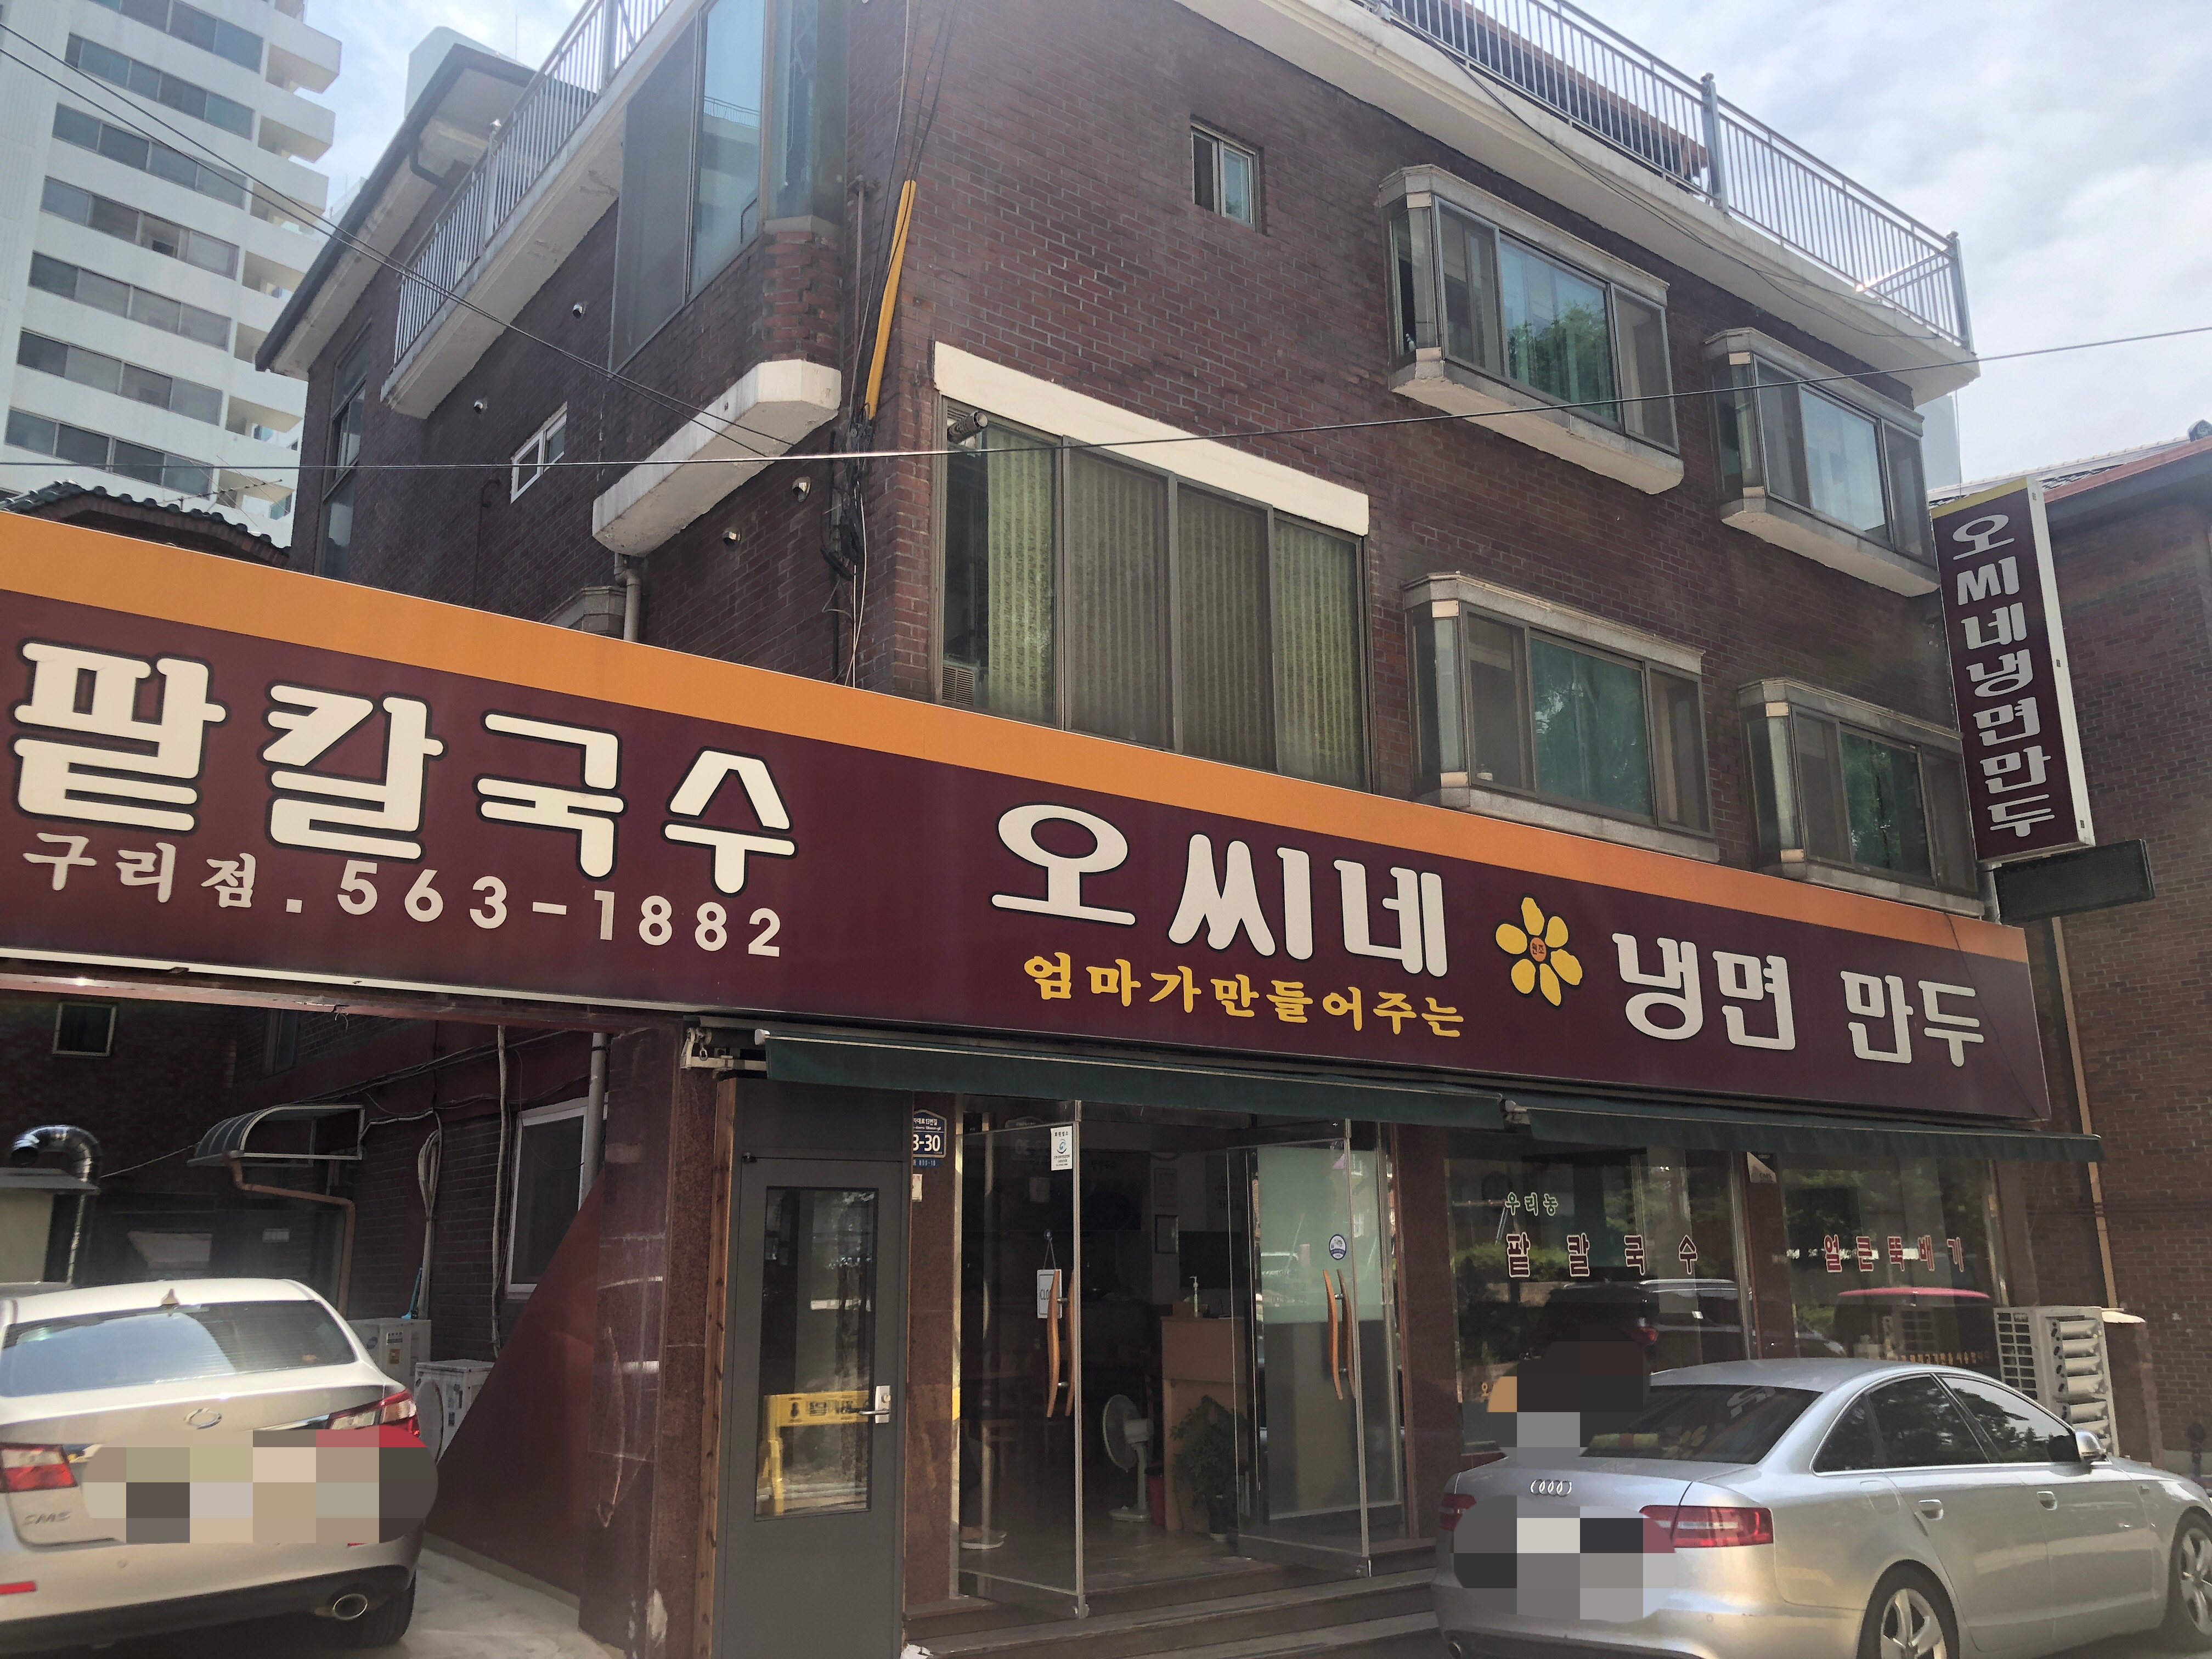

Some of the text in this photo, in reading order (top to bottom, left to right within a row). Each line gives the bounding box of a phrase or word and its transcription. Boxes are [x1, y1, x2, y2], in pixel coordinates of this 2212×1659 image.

[1952, 514, 2055, 838] 오씨네냉면만두
[12, 640, 797, 896] 팥칼국수
[990, 802, 1984, 1068] 오씨네 냉면 만두
[913, 1134, 941, 1152] 3-30
[1505, 1232, 1699, 1278] 팥칼국수
[1824, 1234, 1965, 1273] 얼큰뚝배기
